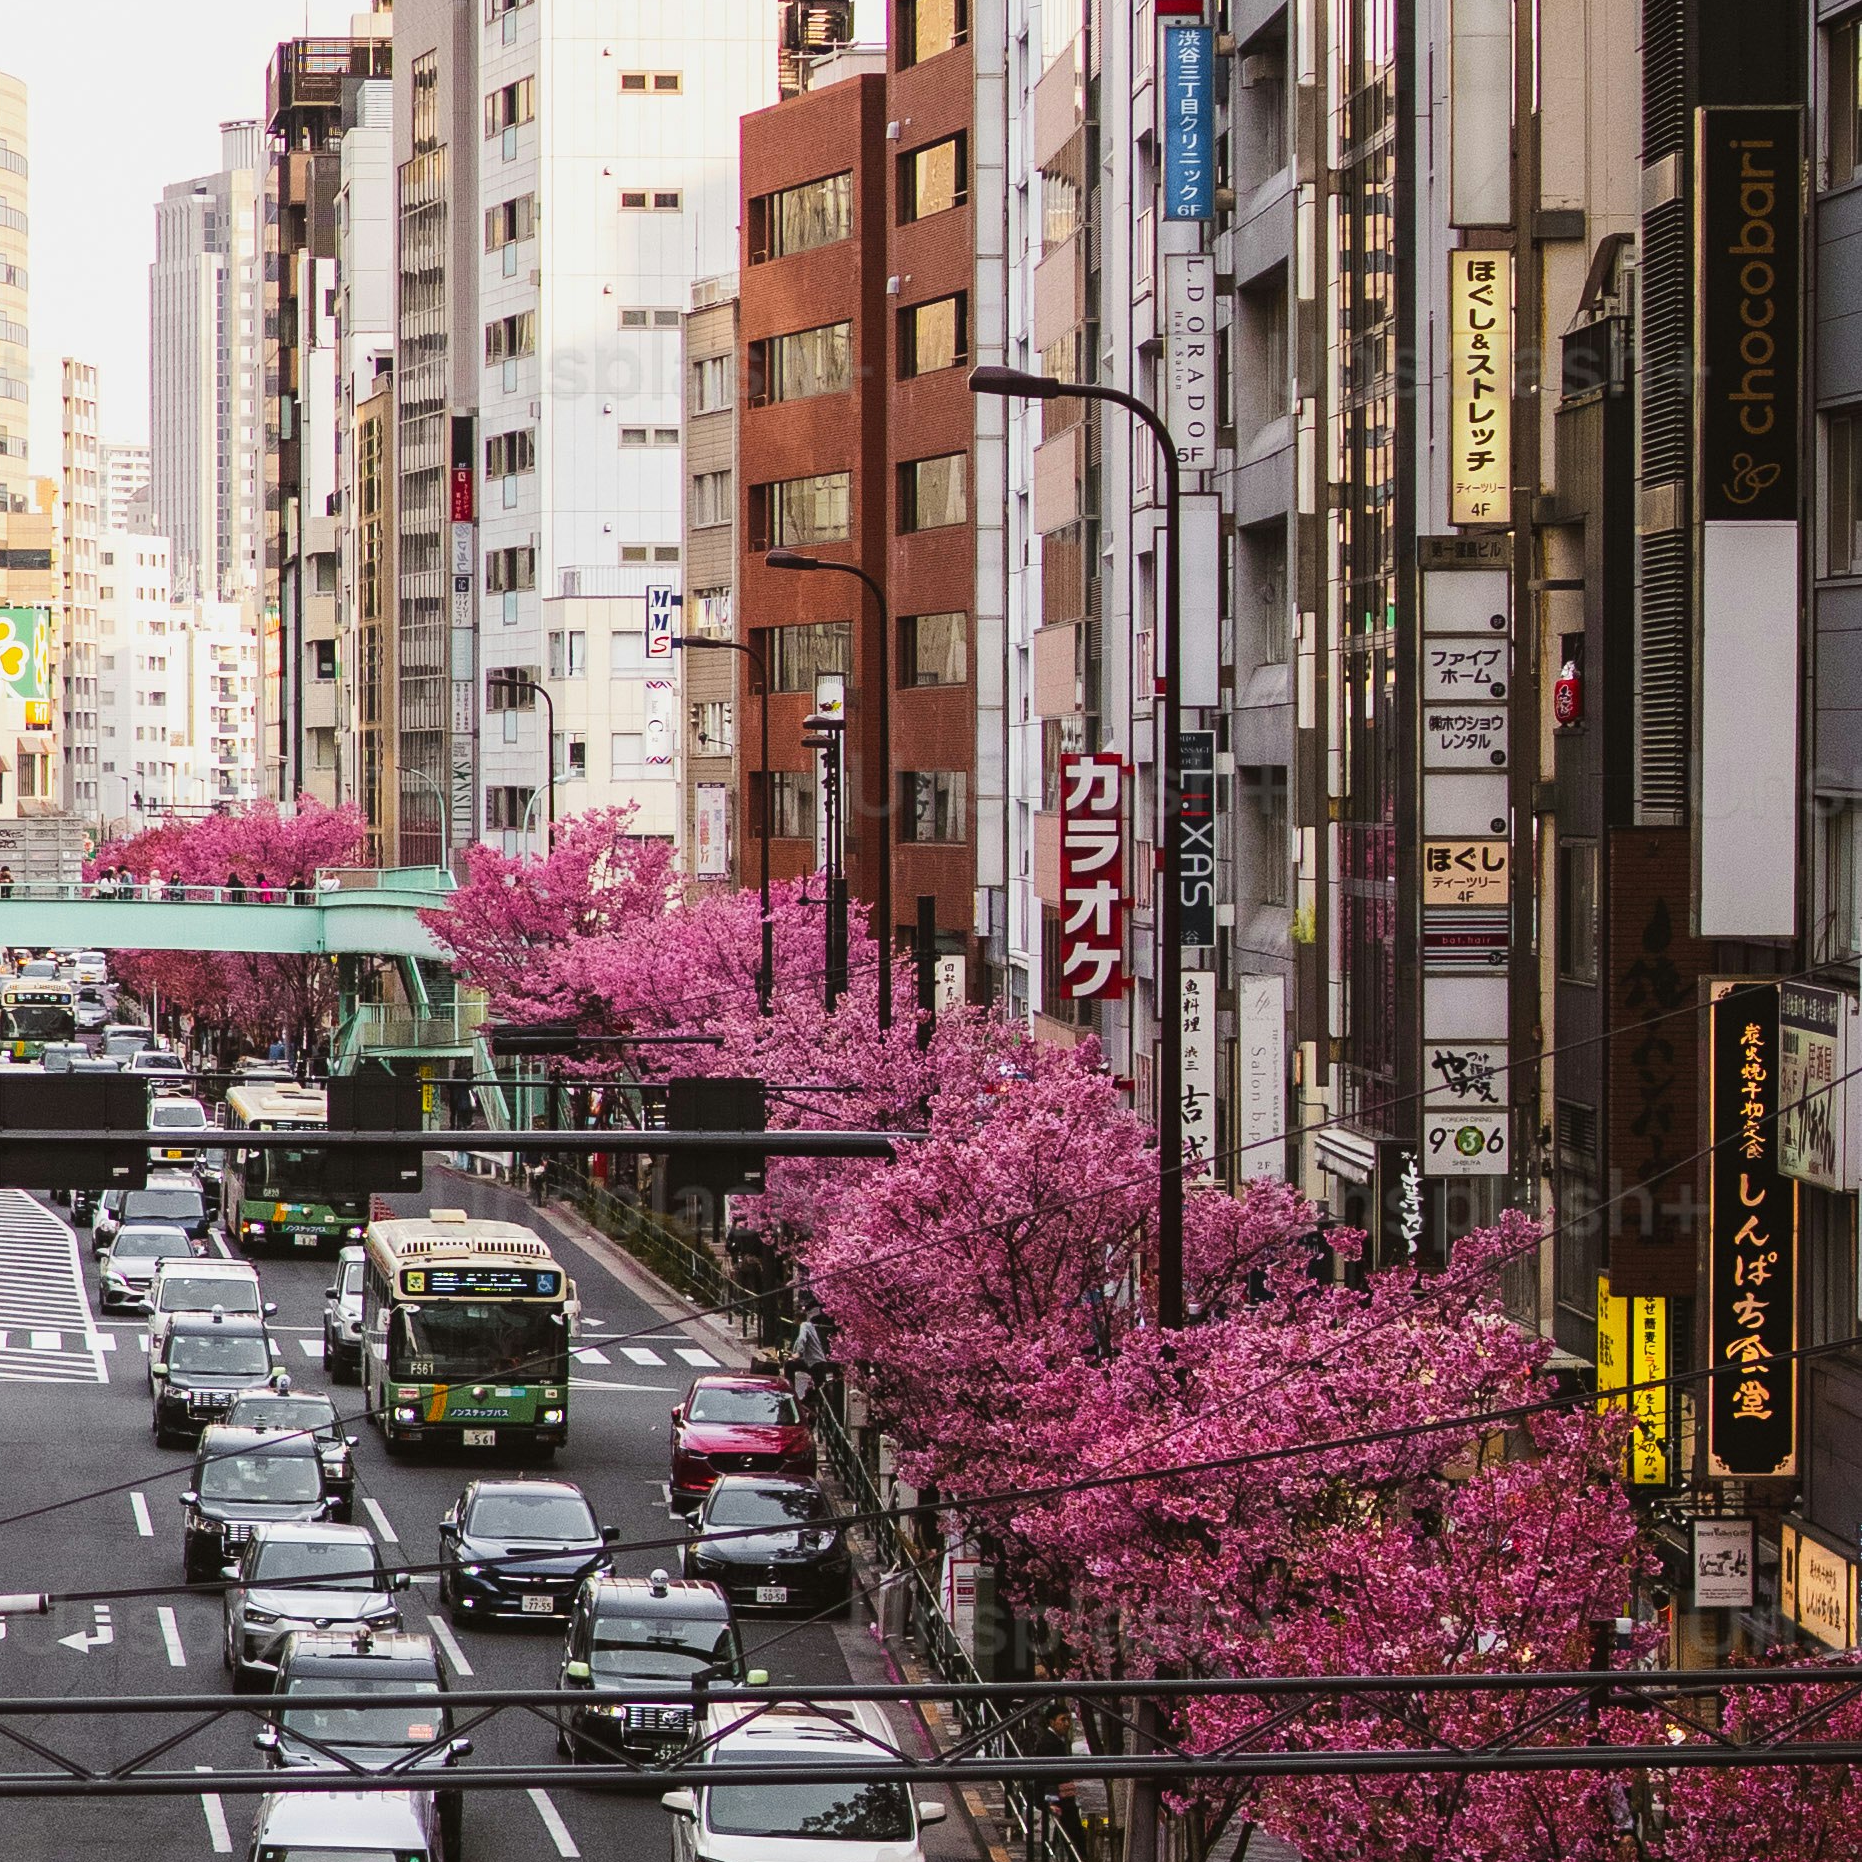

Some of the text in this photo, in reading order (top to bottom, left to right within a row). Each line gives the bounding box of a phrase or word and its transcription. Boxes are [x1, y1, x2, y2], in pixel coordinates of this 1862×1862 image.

[1178, 29, 1199, 201] 渋谷三丁目クリニック
[1177, 204, 1200, 217] 6F
[1729, 140, 1774, 434] chocobari
[1465, 261, 1496, 472] ほぐし&ストレッチ
[1177, 447, 1203, 463] 5F
[1471, 502, 1491, 517] 4F
[651, 590, 670, 653] MMS
[1440, 669, 1492, 684] ホーム
[1441, 734, 1491, 750] レンタル
[1427, 845, 1506, 872] ほぐし
[1063, 756, 1121, 998] カラオケ
[1432, 876, 1501, 888] ティーツリー
[1457, 891, 1475, 903] 4F
[1183, 979, 1201, 1032] 魚料理
[1184, 1046, 1199, 1071] 渋三
[1251, 1046, 1267, 1102] Salon
[1740, 1022, 1767, 1158] 炭火焼干物定食
[1257, 1162, 1271, 1170] 2F
[1725, 1173, 1778, 1421] しんぱち食堂
[410, 1362, 435, 1375] F561
[528, 1602, 552, 1611] 77-55
